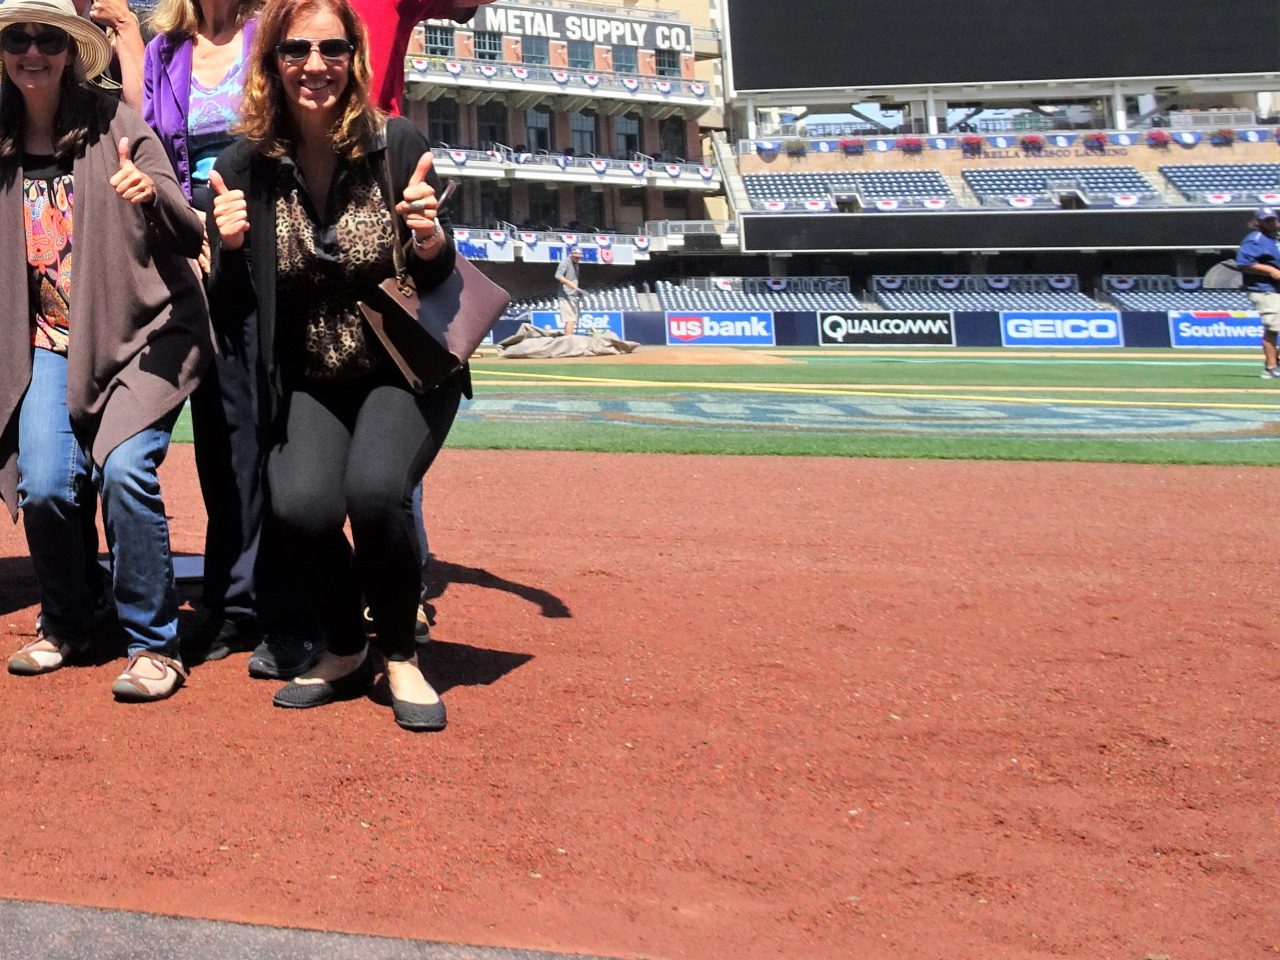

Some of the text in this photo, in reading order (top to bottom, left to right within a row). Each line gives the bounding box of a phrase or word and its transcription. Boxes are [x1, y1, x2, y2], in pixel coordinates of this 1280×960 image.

[485, 6, 560, 39] METAL
[566, 16, 647, 47] SUPPLY
[655, 25, 692, 51] CO.
[554, 314, 610, 329] VSat
[823, 315, 949, 342] QUALCOMM
[1006, 318, 1118, 339] GEICO
[1179, 321, 1264, 338] Southwes
